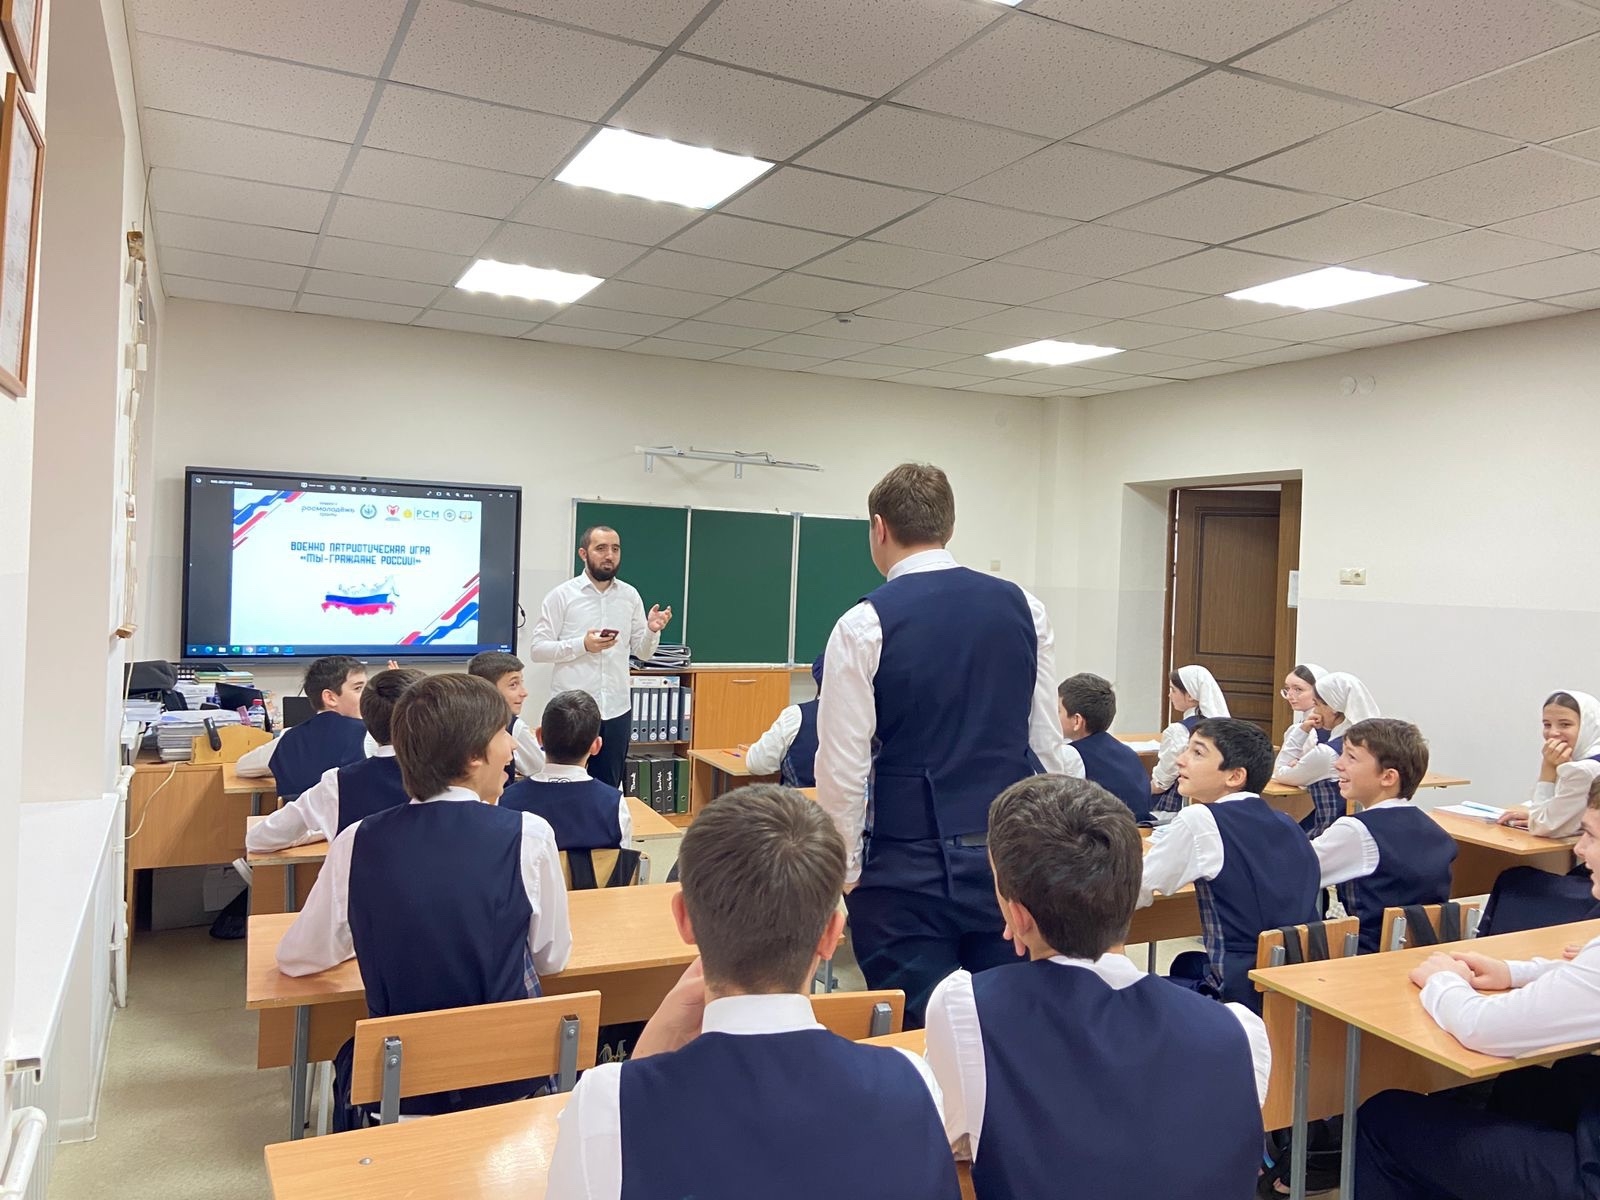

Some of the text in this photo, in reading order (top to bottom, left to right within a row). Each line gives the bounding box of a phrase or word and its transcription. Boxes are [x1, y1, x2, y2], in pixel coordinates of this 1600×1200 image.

[416, 509, 440, 518] РСМ
[290, 541, 431, 556] ВОЕННО ПАТРИОТИЧЕСКАЯ ИГРА
